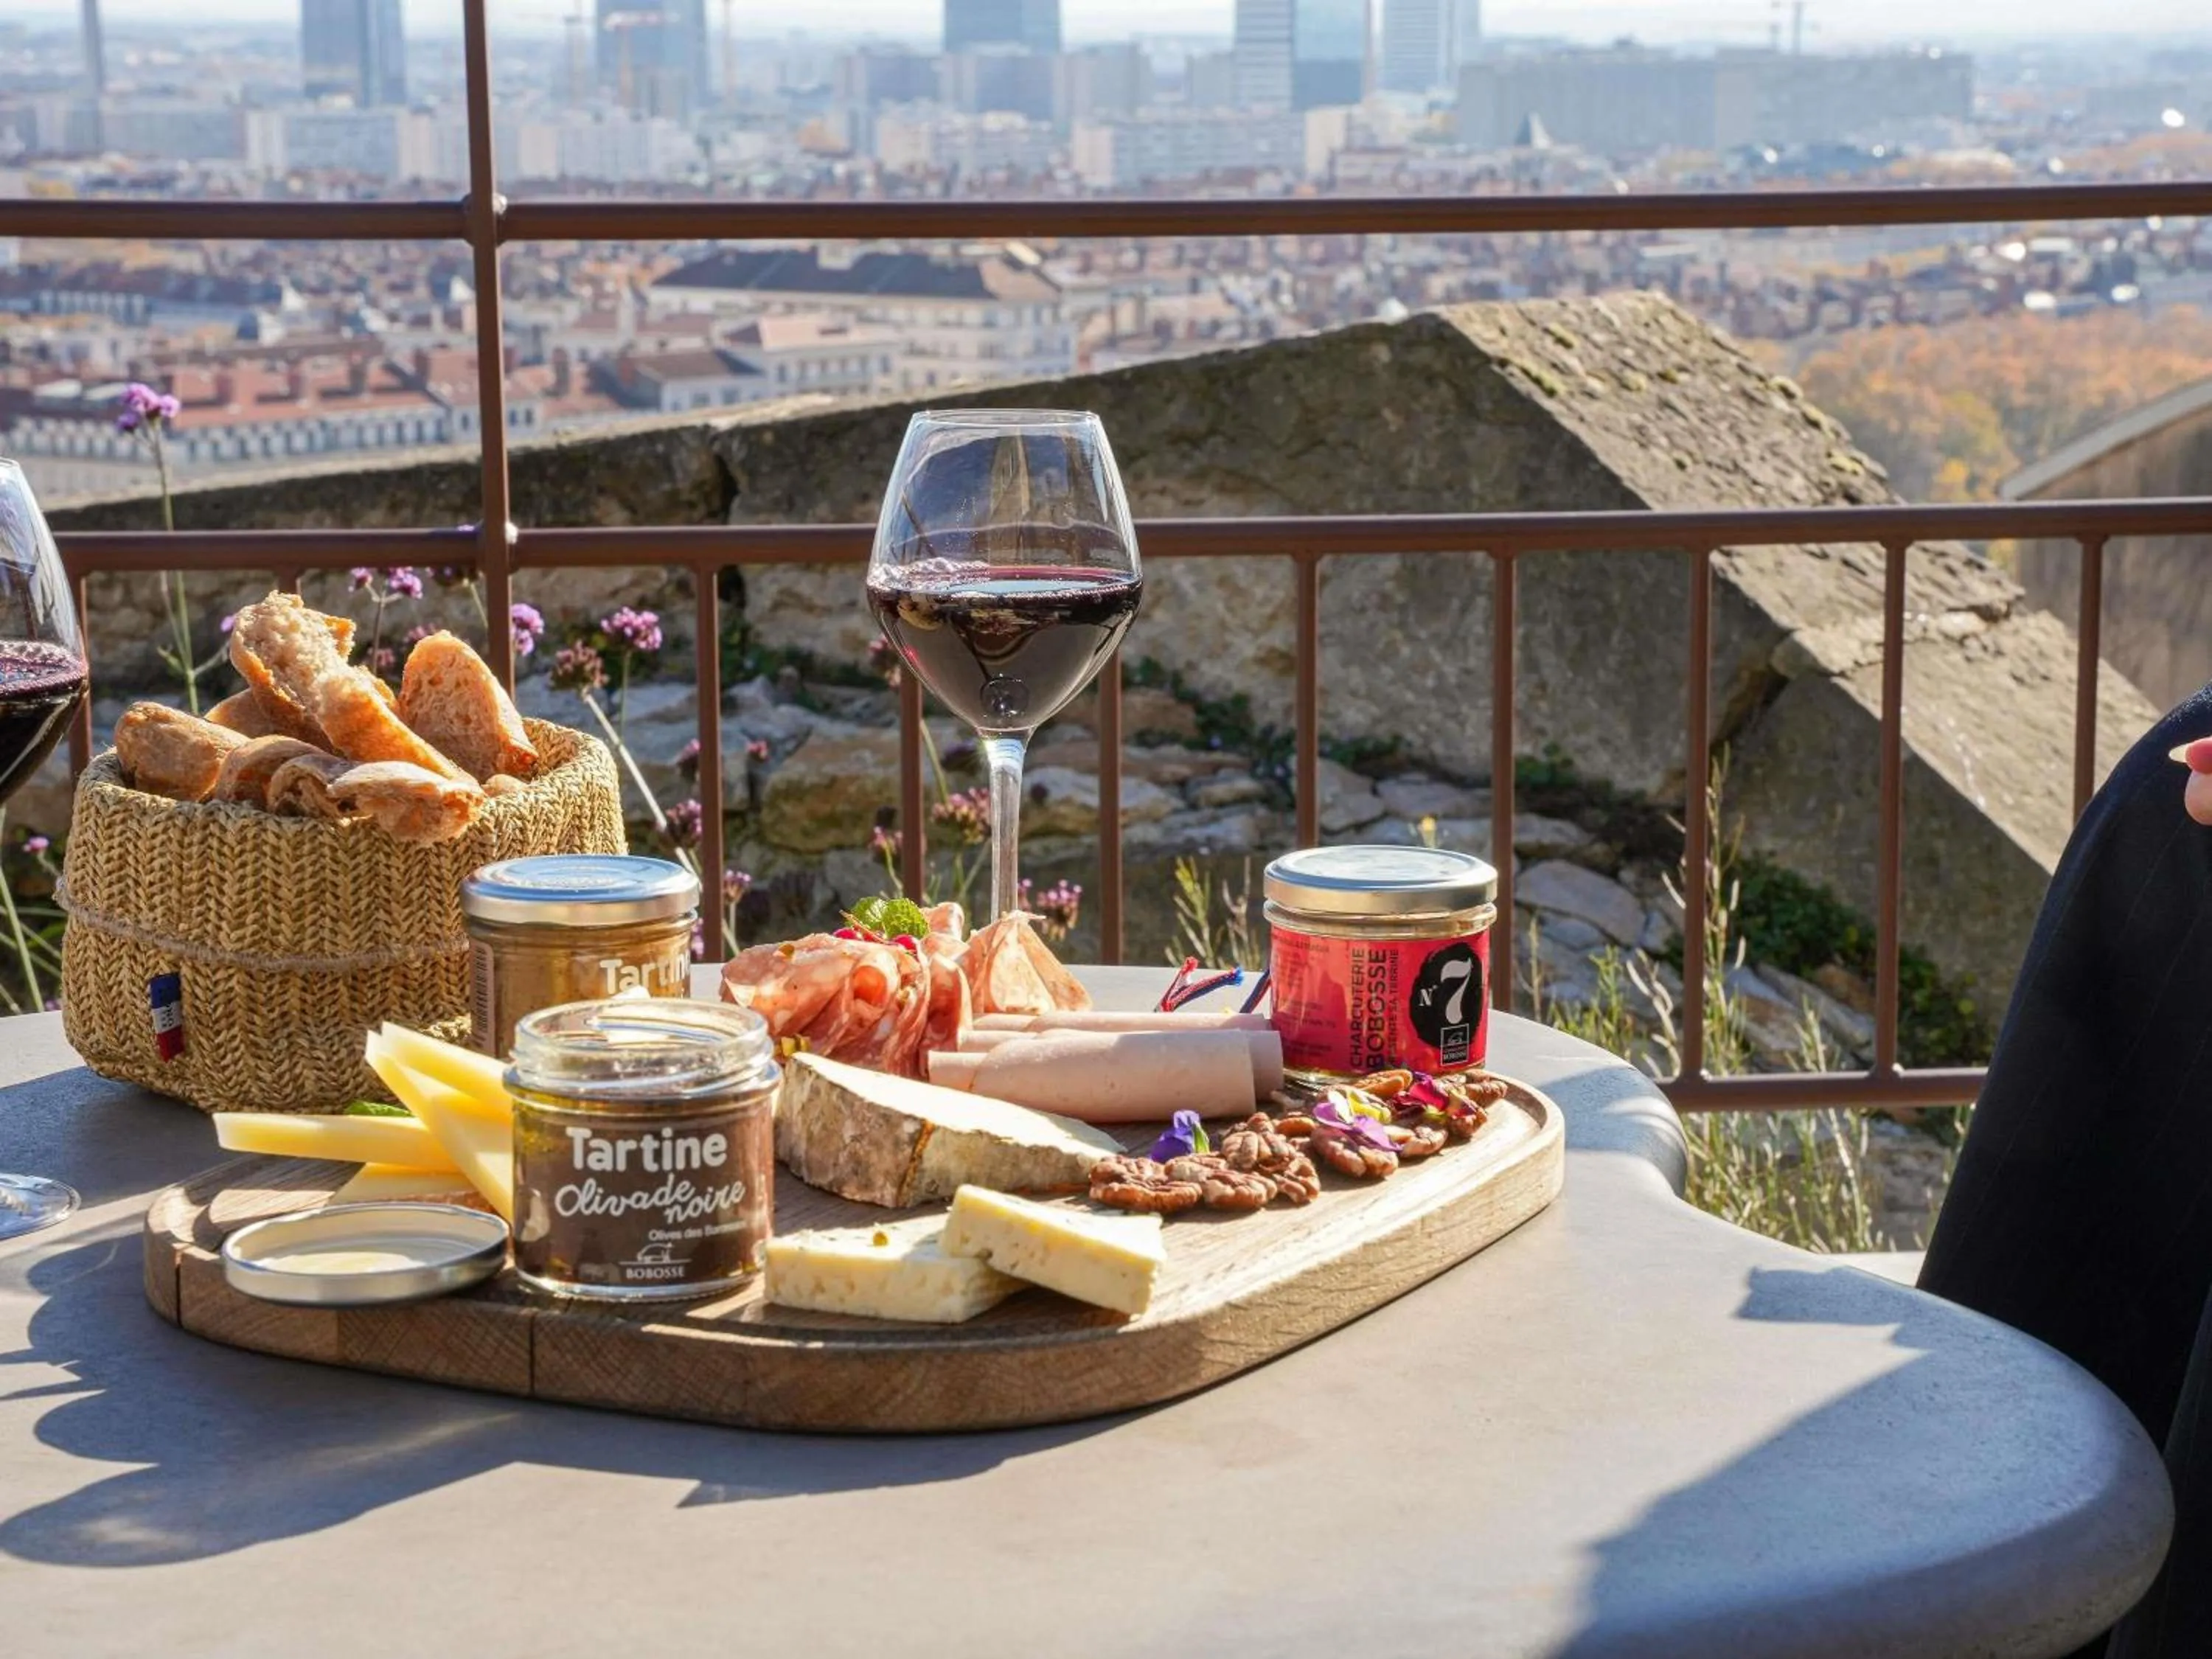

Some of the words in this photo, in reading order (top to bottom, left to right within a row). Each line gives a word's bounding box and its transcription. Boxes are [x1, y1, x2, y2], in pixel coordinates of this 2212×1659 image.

[1350, 948, 1366, 1068] CHARCUTERIE
[1366, 949, 1388, 1070] BOBOSSE
[1441, 958, 1473, 1024] 7
[566, 1127, 727, 1172] Tartine
[555, 1172, 695, 1217] Olivade
[664, 1180, 746, 1225] noire
[626, 1266, 685, 1279] BOBOSSE
